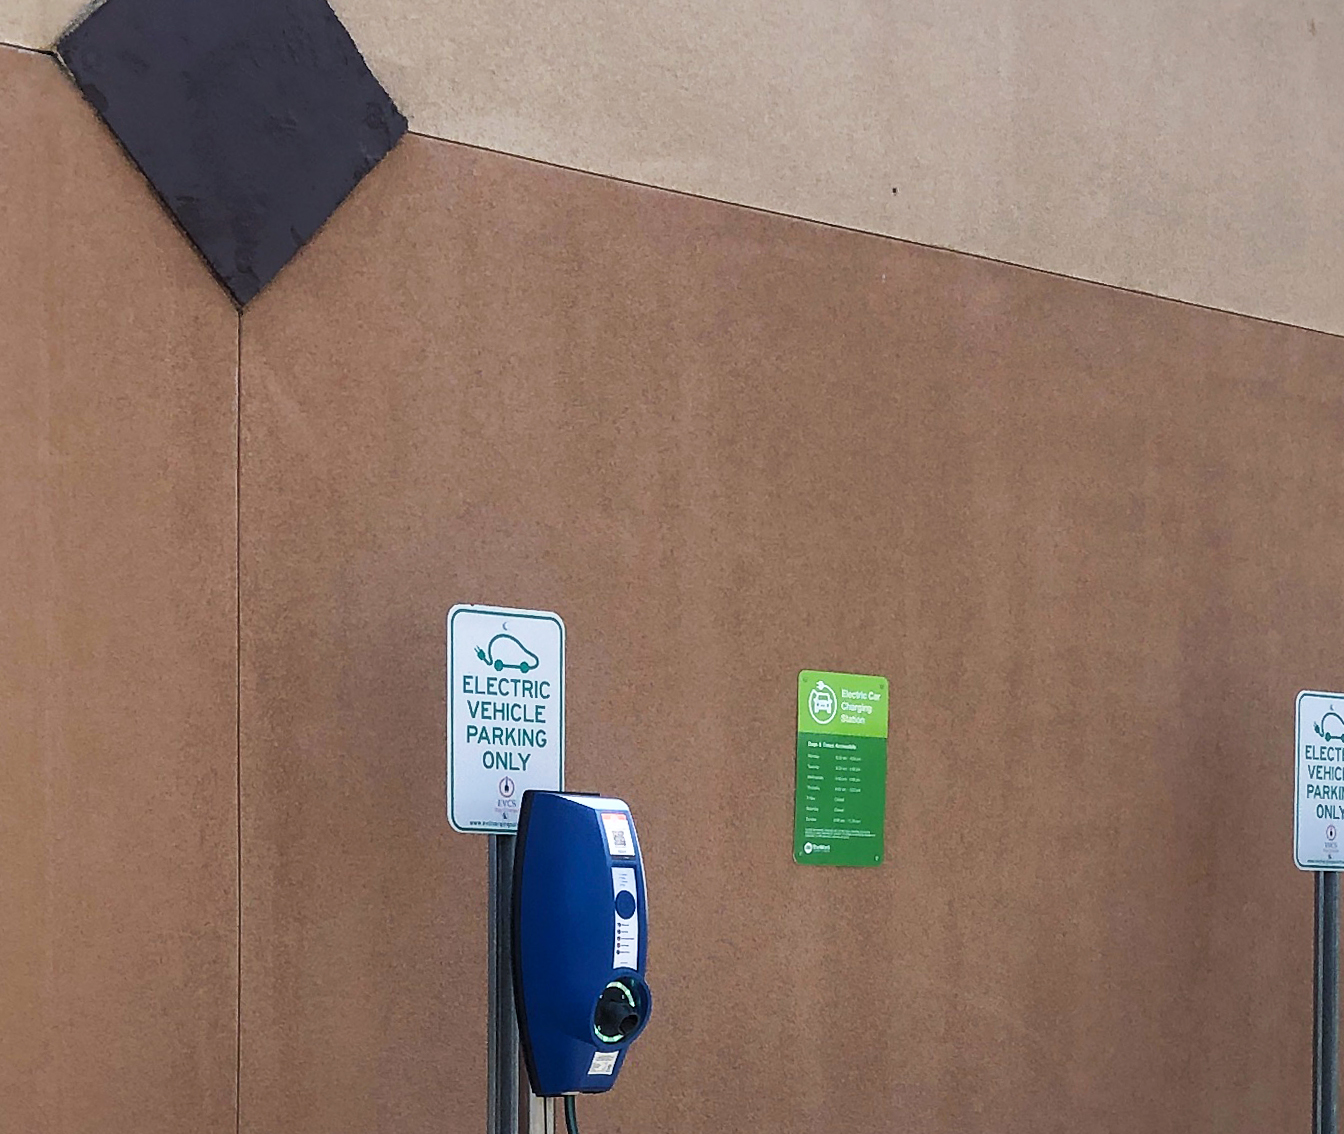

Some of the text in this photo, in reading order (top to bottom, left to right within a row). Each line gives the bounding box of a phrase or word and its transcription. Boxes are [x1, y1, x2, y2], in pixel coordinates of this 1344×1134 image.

[463, 675, 551, 700] ELECTRIC
[841, 689, 881, 701] Electric Car
[467, 699, 546, 724] VEHICLE
[840, 713, 866, 724] Station
[841, 702, 872, 714] Charging
[466, 725, 547, 748] PARKING
[482, 750, 531, 771] ONLY
